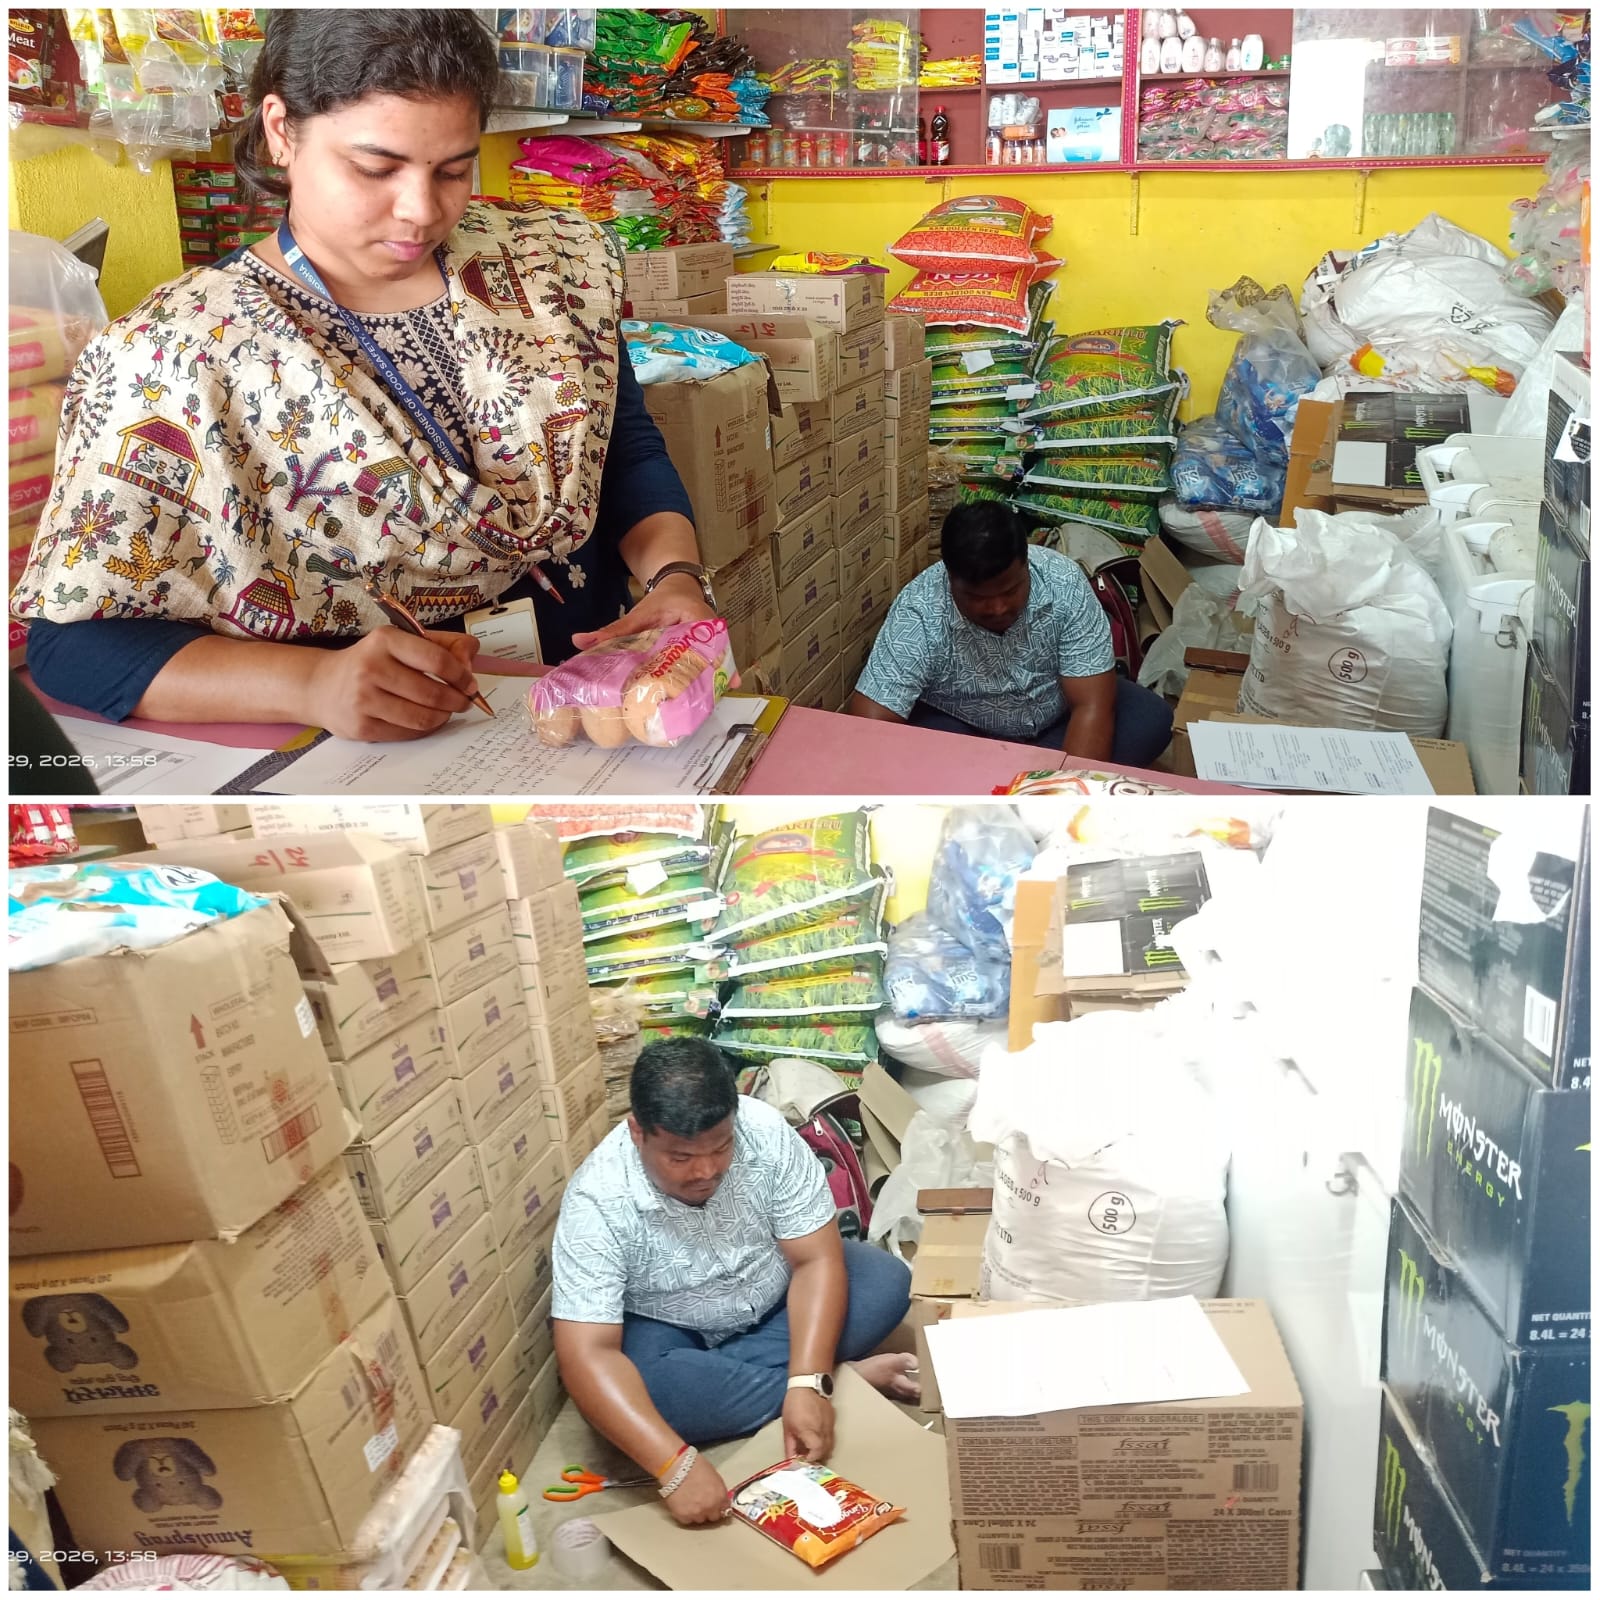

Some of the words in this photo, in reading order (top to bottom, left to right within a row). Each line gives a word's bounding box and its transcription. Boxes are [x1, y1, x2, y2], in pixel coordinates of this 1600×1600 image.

[299, 263, 327, 297] ODISHA
[359, 333, 388, 371] SAFETY,
[385, 369, 407, 399] FOOD
[405, 396, 417, 410] OF
[1339, 659, 1354, 680] 500
[1350, 651, 1360, 661] g
[1438, 1092, 1523, 1200] MONSTER
[1447, 1142, 1506, 1208] ENERGY
[1018, 1188, 1032, 1204] 500
[1033, 1195, 1041, 1207] g
[1102, 1206, 1118, 1231] 500
[1114, 1196, 1125, 1207] g
[1531, 1313, 1550, 1322] NET
[1529, 1329, 1556, 1341] 8.4L
[1569, 1329, 1586, 1340] 24
[1423, 1314, 1501, 1447] MONSTER
[1081, 1415, 1100, 1423] THIS
[1103, 1415, 1146, 1423] CONTAINS
[1148, 1415, 1199, 1423] SUCRALOSE
[1119, 1437, 1171, 1449] fssai
[1120, 1500, 1173, 1513] fssai
[1268, 1508, 1293, 1516] Cans
[134, 1530, 254, 1549] Amulspray
